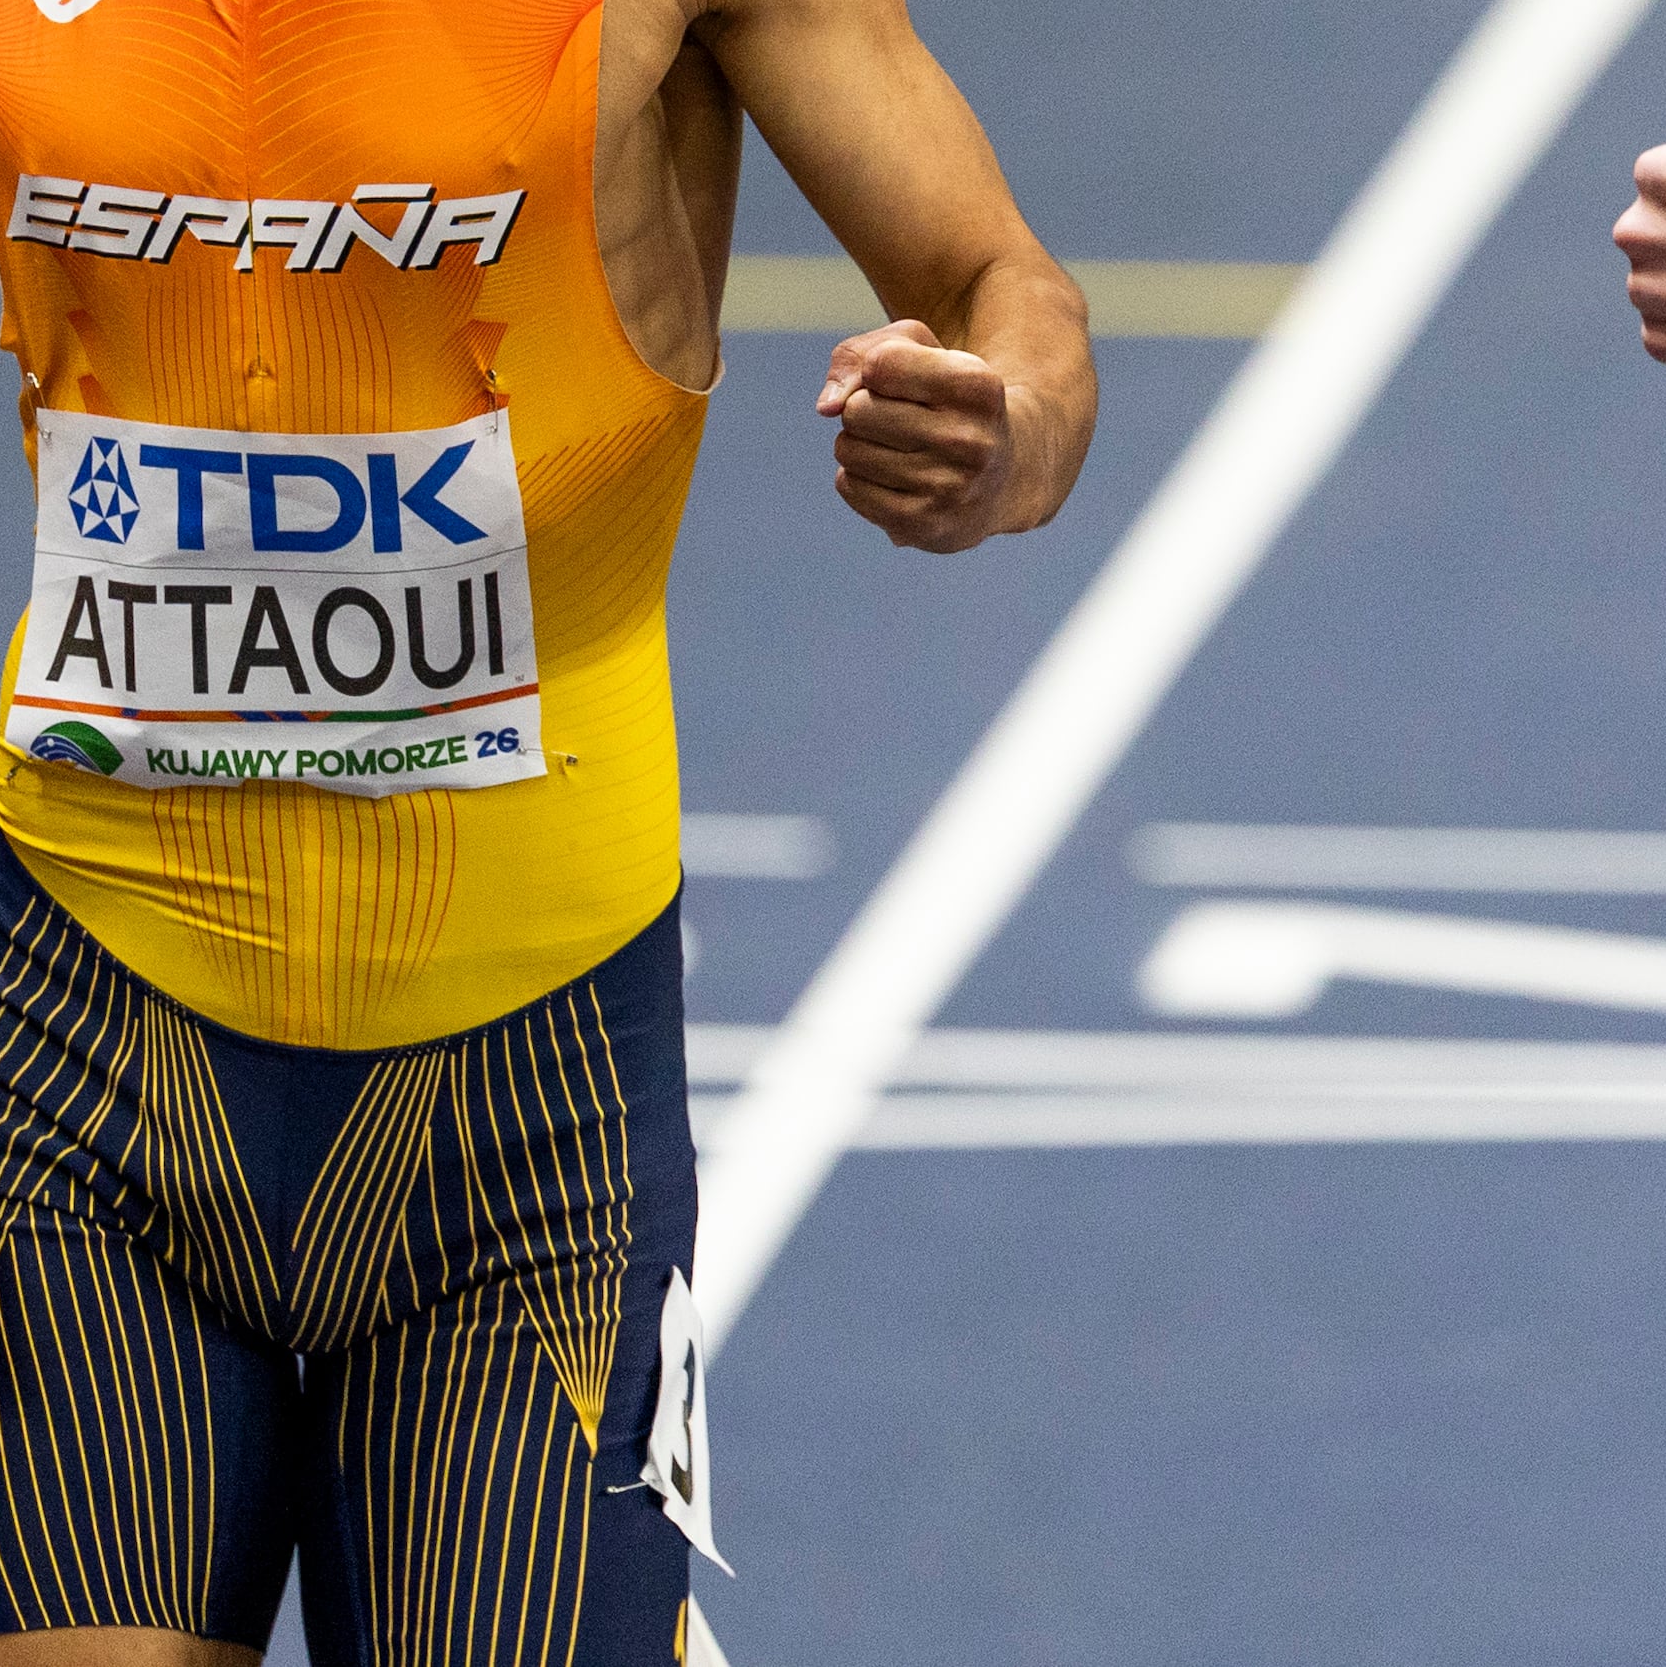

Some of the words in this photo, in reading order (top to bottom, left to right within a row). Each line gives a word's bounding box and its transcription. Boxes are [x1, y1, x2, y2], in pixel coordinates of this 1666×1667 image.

[6, 174, 526, 272] ESPAÑA
[139, 439, 489, 554] TDK
[46, 572, 506, 696] ATTAOUI
[146, 747, 287, 778] KUJAWY
[295, 735, 469, 778] POMORZE
[473, 727, 520, 759] 26
